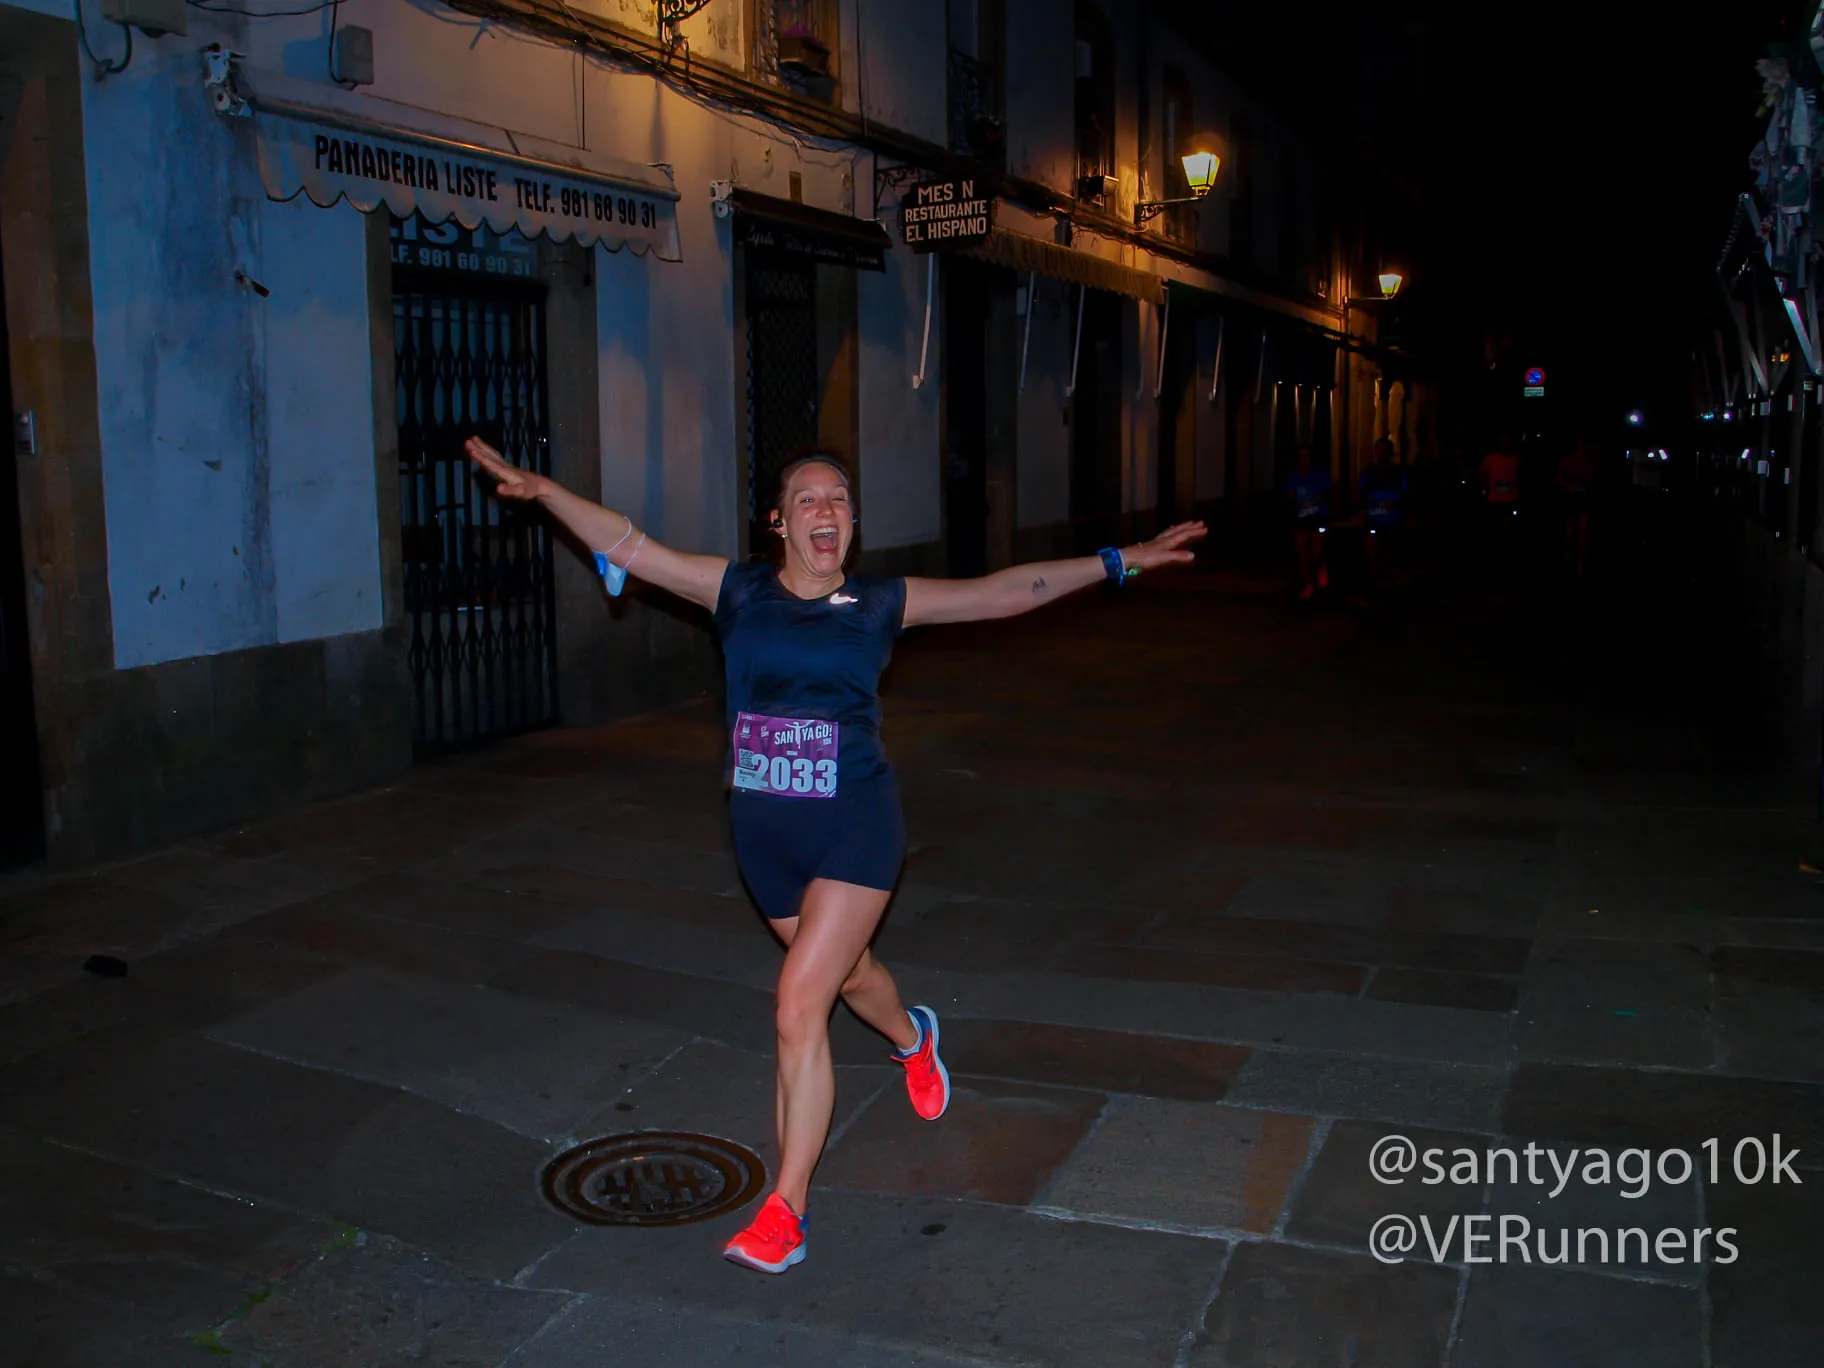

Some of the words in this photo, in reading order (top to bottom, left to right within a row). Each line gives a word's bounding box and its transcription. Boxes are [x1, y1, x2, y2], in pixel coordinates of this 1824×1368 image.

[315, 135, 438, 191] PANADERIA
[445, 162, 498, 202] LISTE
[514, 177, 555, 214] TELF.
[561, 187, 589, 218] 981
[618, 198, 636, 226] 90
[641, 201, 656, 229] 31
[904, 200, 988, 223] RESTAURANTE
[906, 224, 924, 242] EL
[927, 217, 987, 240] HISPANO
[418, 247, 451, 270] 981
[485, 254, 508, 275] 90
[512, 258, 532, 277] 31
[751, 753, 838, 793] 2033
